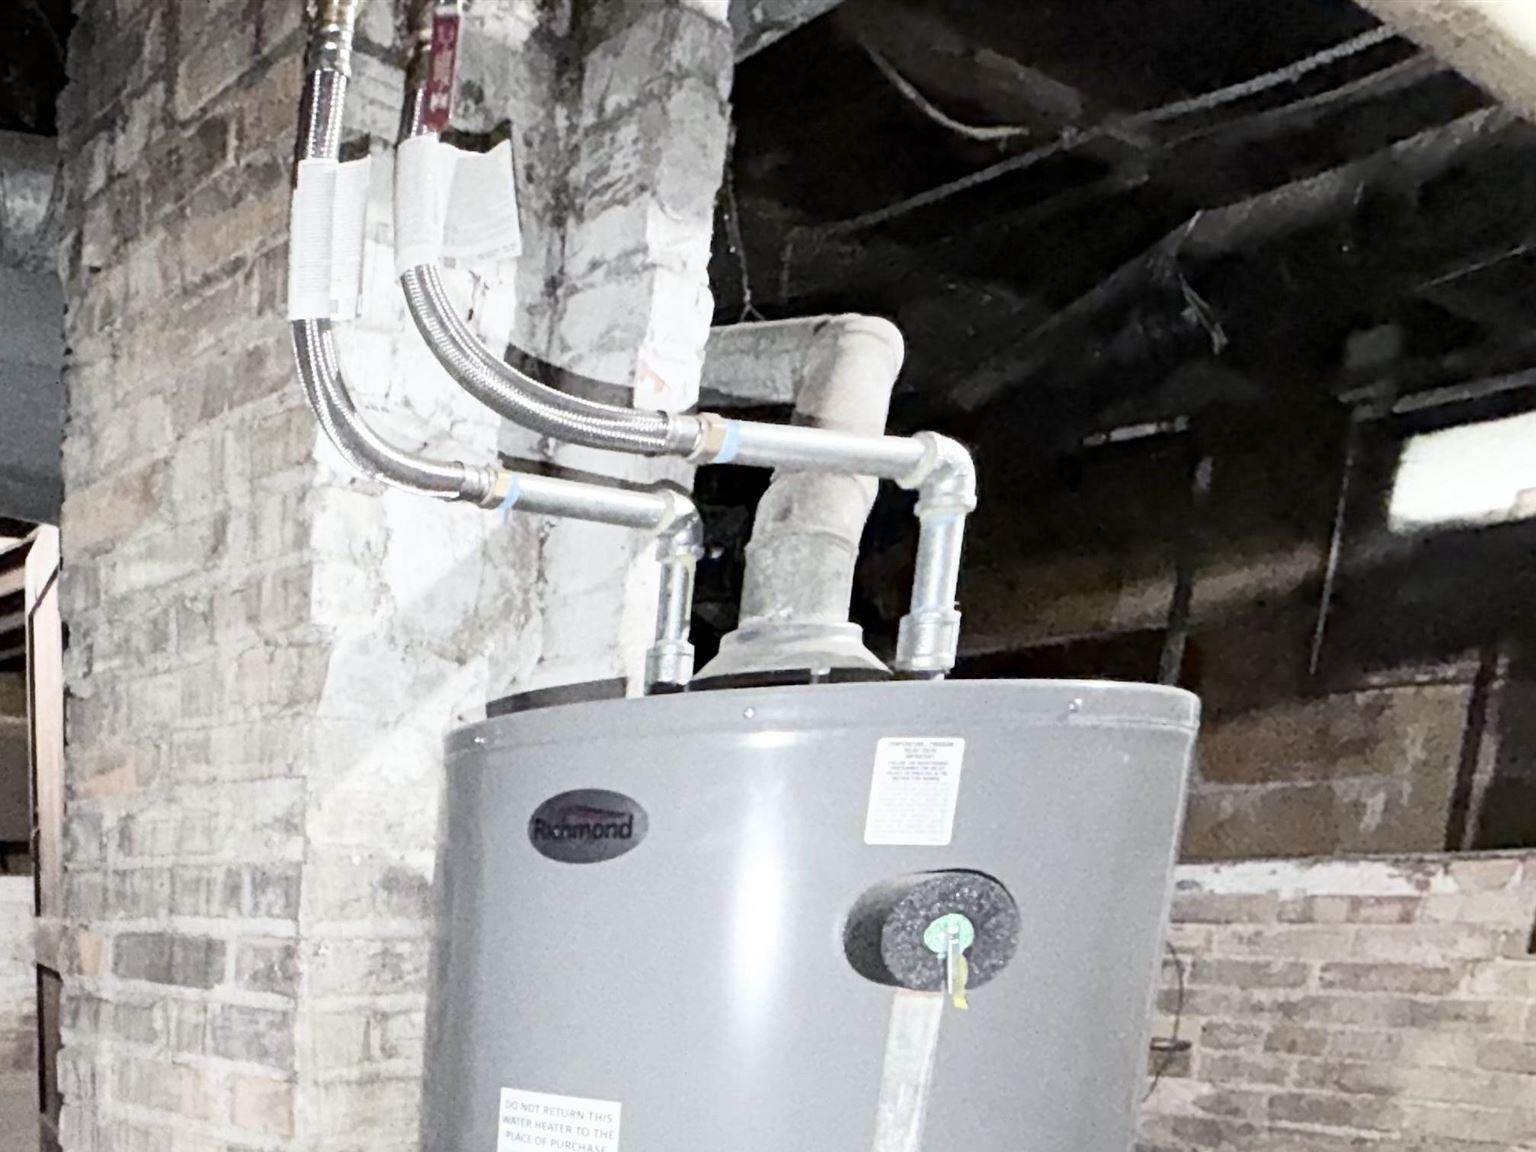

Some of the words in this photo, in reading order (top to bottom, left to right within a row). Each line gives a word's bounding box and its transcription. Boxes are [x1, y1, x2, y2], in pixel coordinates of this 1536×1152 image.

[505, 1100, 518, 1111] DO
[521, 1102, 540, 1113] NOT
[543, 1105, 584, 1120] RETURN
[589, 1111, 613, 1123] THIS
[502, 1115, 532, 1129] WATER
[535, 1120, 572, 1134] HEATER
[576, 1126, 590, 1137] TO
[594, 1128, 615, 1140] THE
[505, 1130, 532, 1144] PLACE
[535, 1135, 547, 1146] OF
